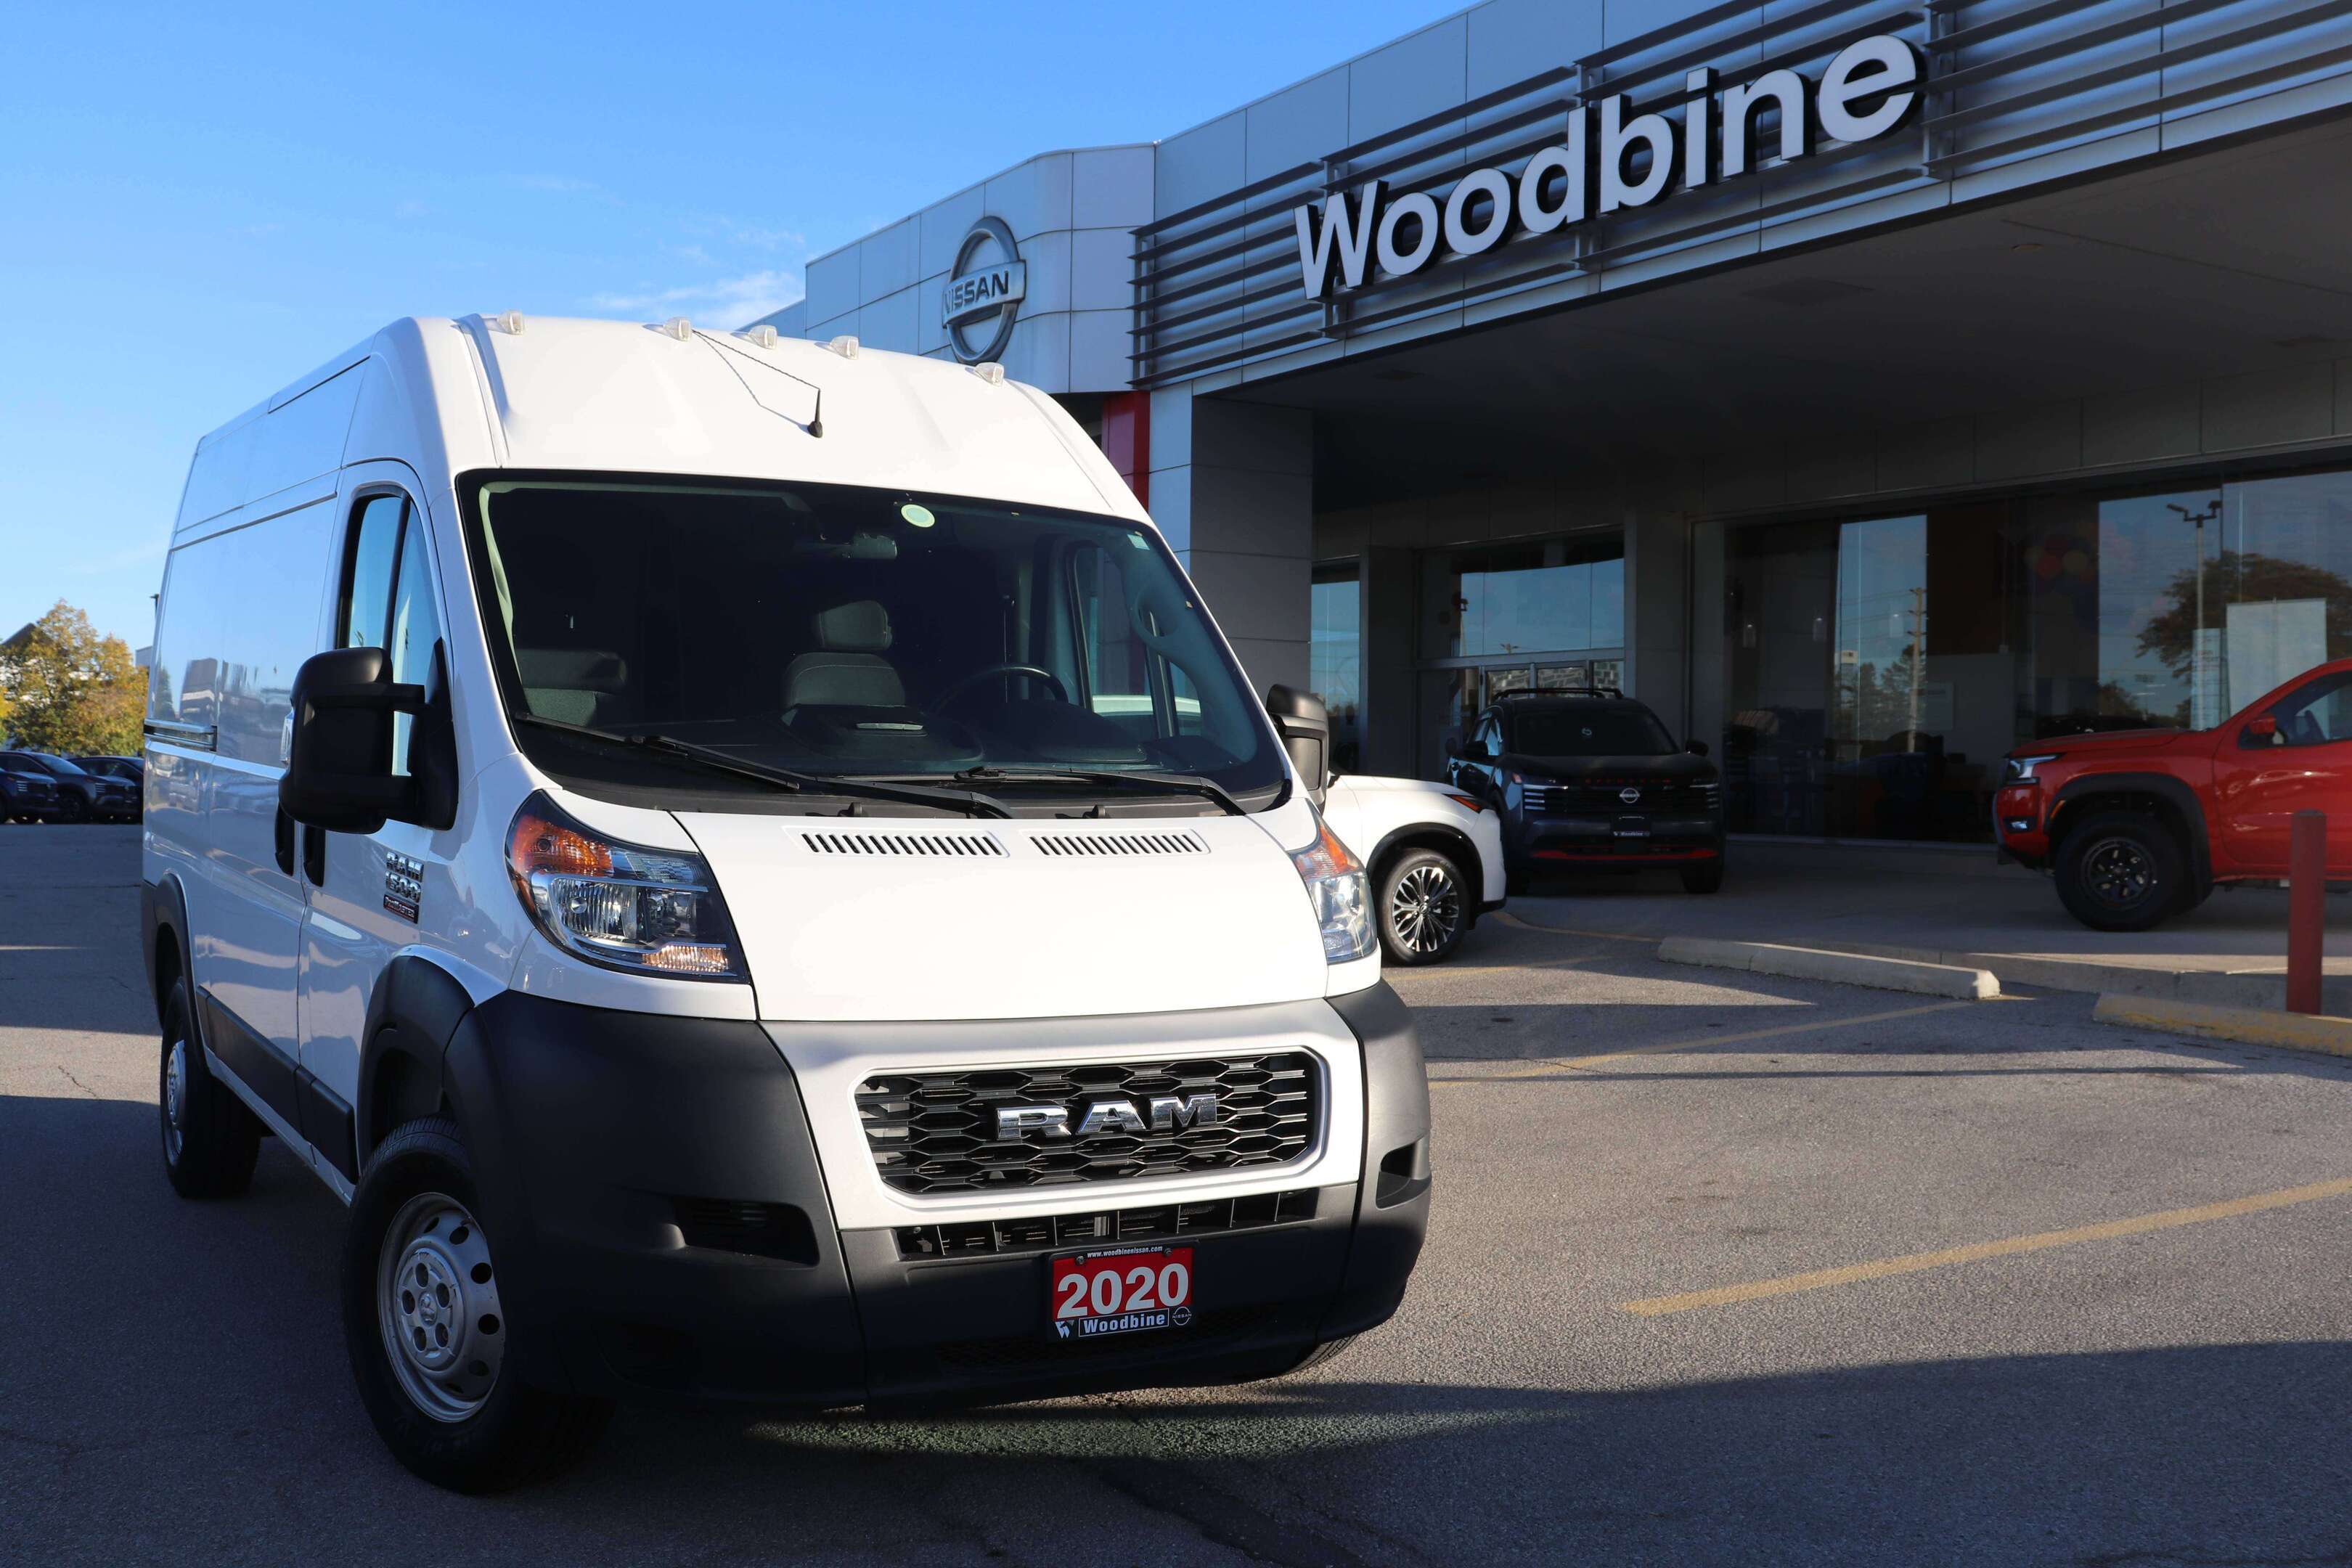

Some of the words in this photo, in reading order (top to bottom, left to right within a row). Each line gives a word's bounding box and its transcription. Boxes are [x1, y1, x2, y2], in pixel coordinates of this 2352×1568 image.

[1294, 34, 1924, 301] Woodbine
[944, 270, 1010, 314] NISSAN
[996, 1092, 1218, 1140] RAM
[1087, 1246, 1163, 1258] www.woodbinenissan.com
[1056, 1262, 1189, 1319] 2020
[1083, 1313, 1165, 1334] Woodbine
